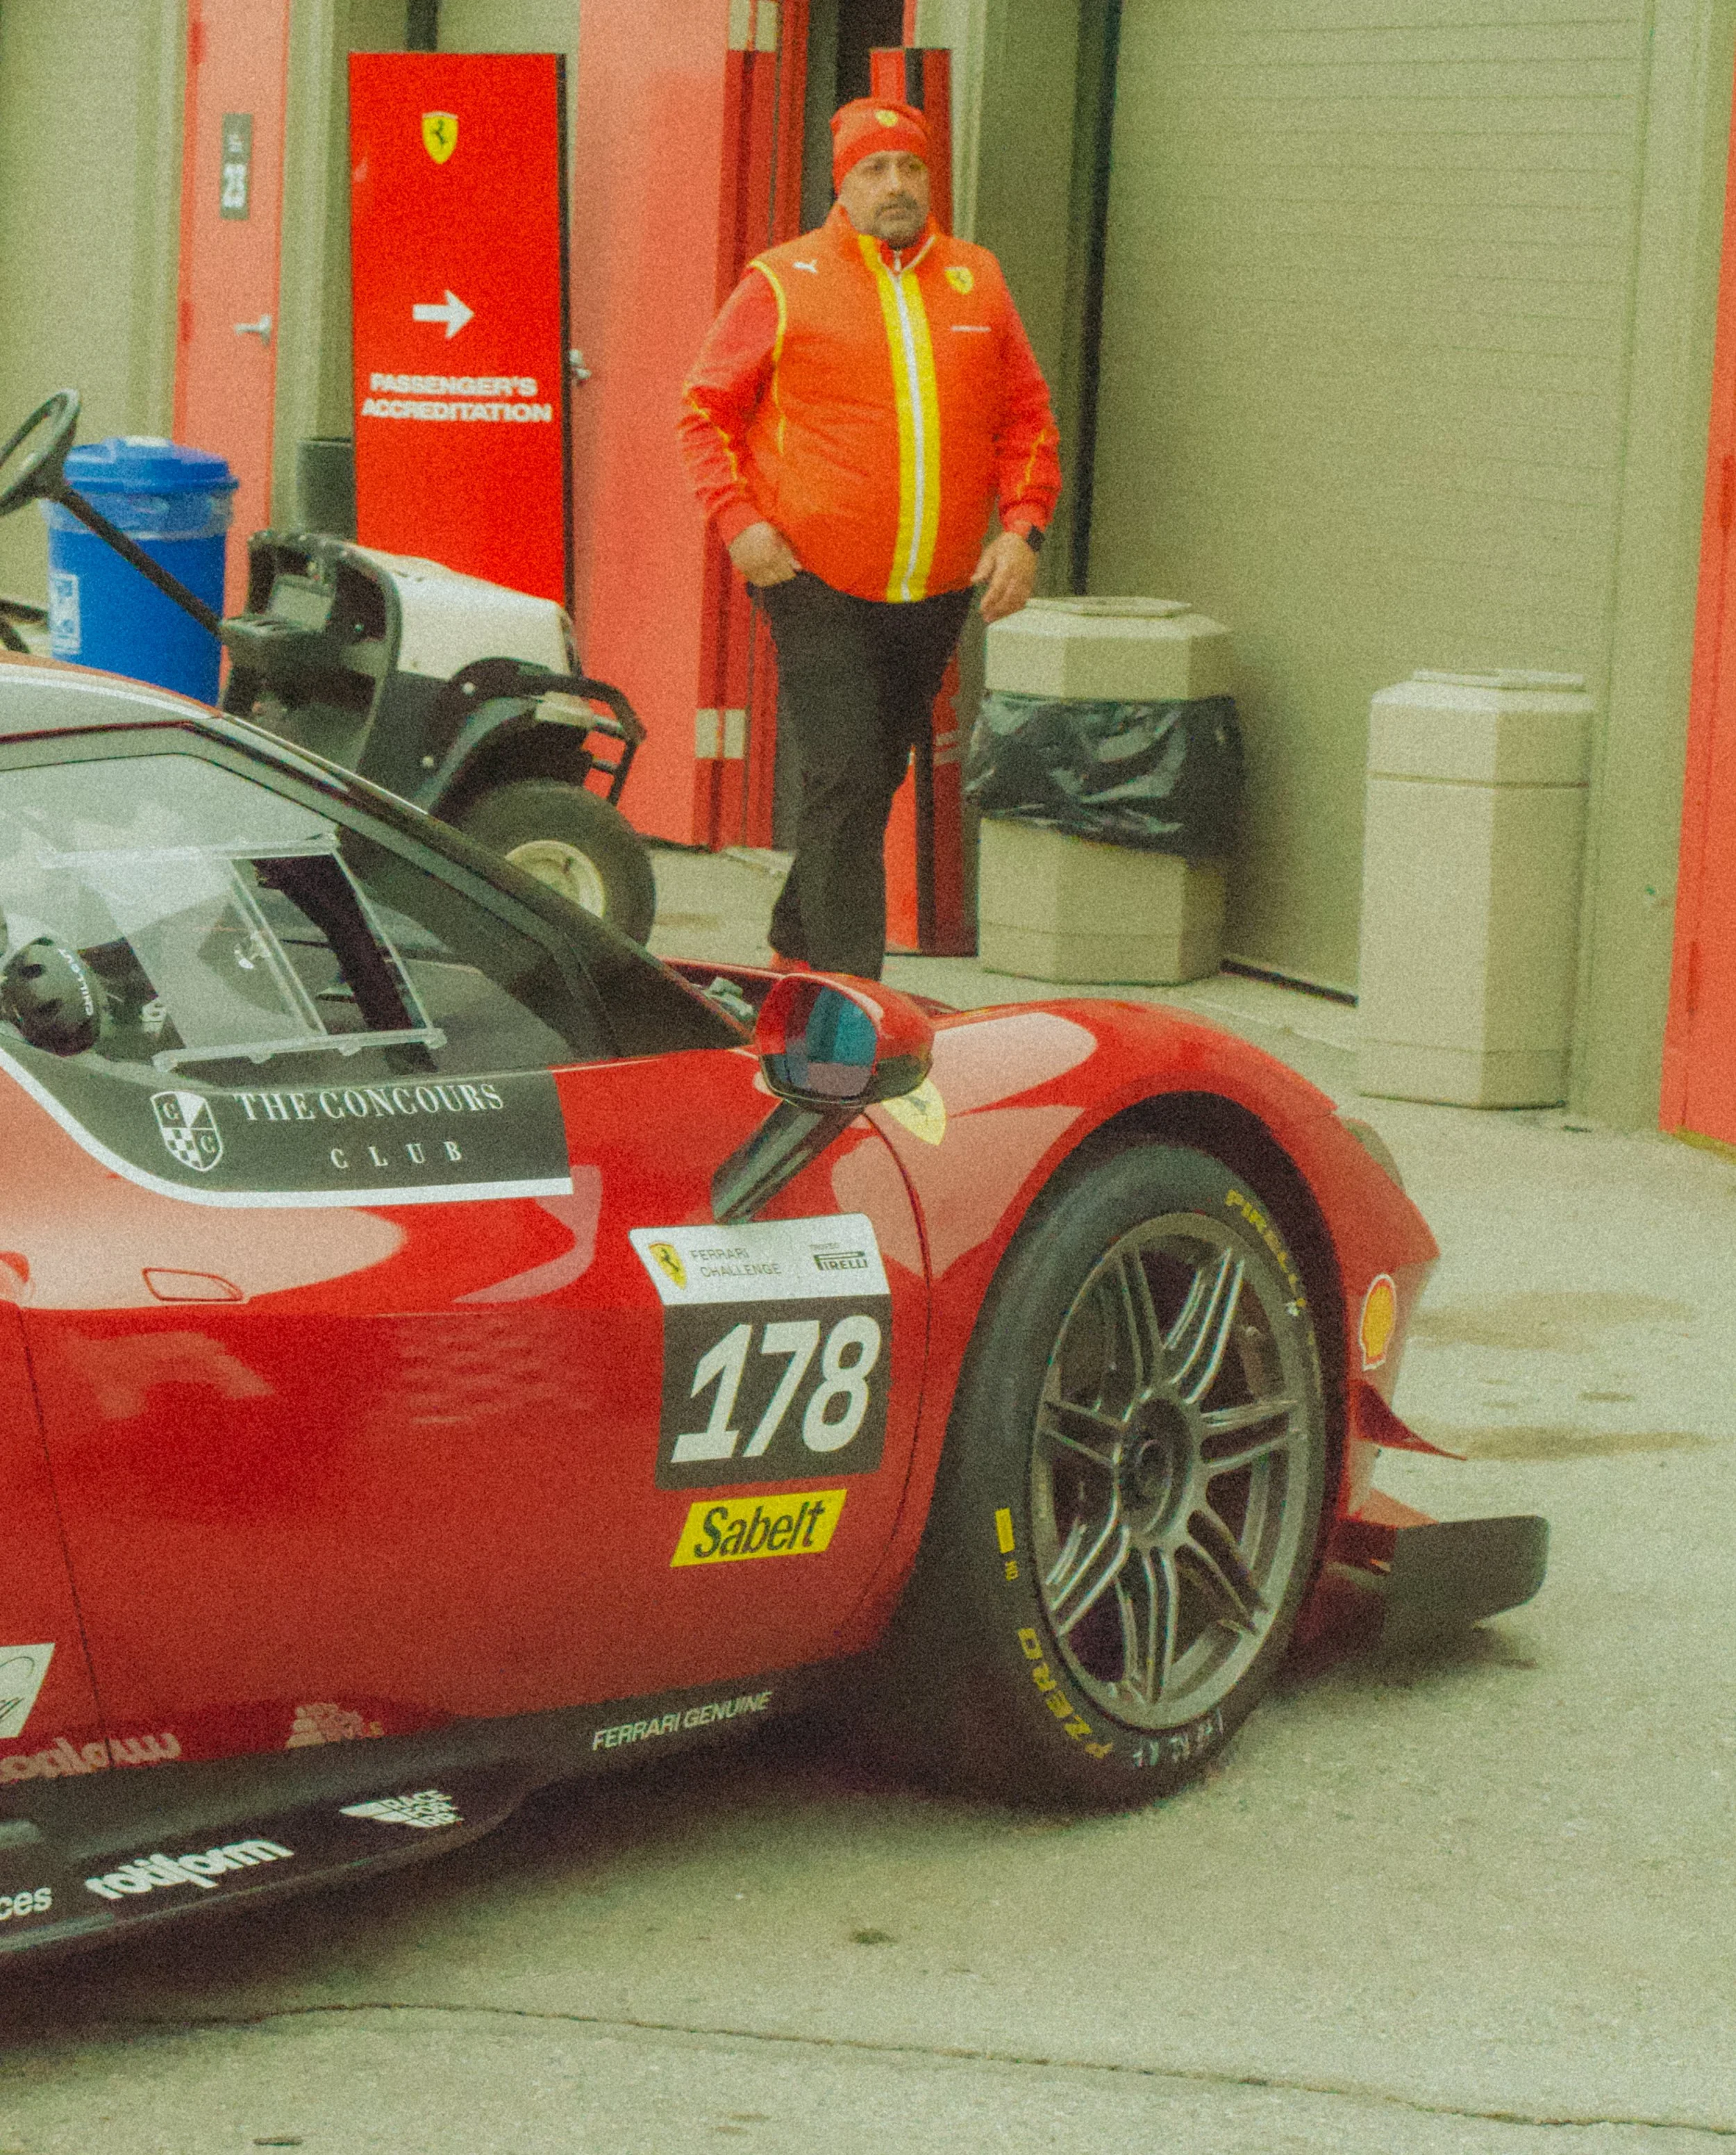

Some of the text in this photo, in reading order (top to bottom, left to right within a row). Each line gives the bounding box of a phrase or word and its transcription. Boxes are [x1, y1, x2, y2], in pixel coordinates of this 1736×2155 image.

[370, 372, 539, 397] PASSENGER'S
[361, 398, 553, 422] ACCREDITATION
[234, 1084, 504, 1121] THE CONCOURS
[690, 1248, 750, 1260] FERRARI
[813, 1251, 868, 1271] PIRELLI
[700, 1263, 782, 1277] CHALLENGE
[671, 1315, 881, 1463] 178
[694, 1500, 826, 1558] Sabelt
[592, 1691, 772, 1751] FERRARI GENUINE
[85, 1840, 294, 1900] rotiform
